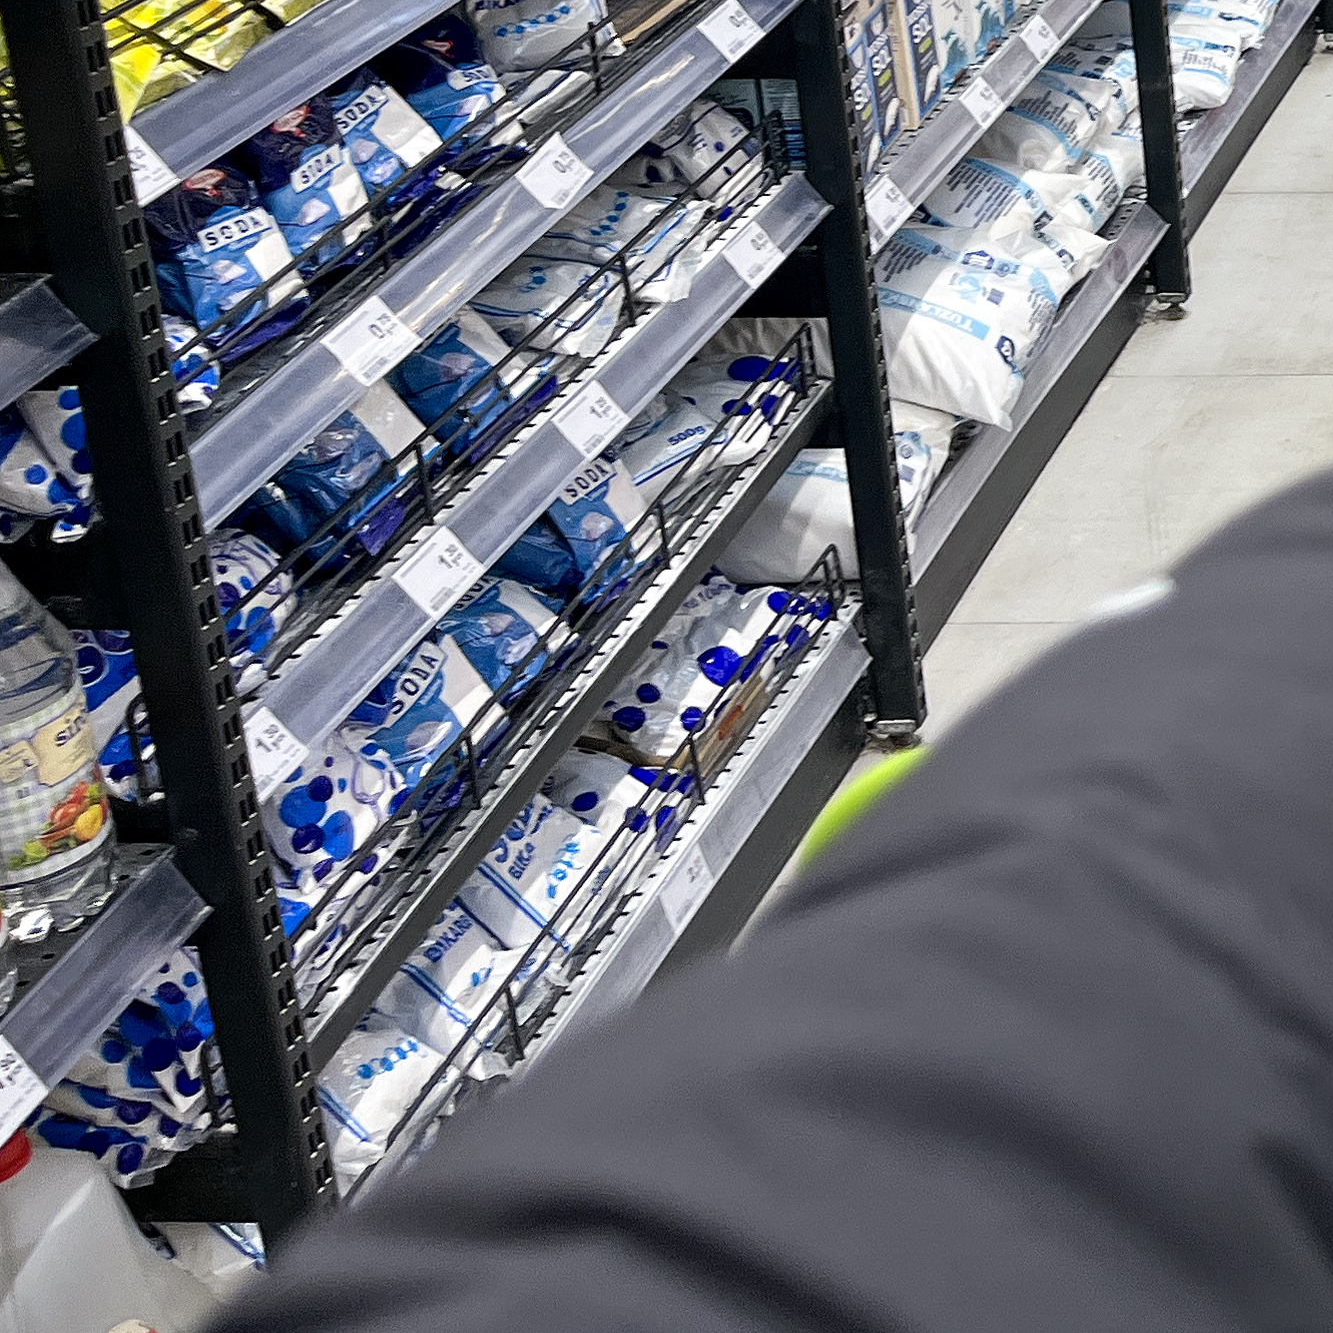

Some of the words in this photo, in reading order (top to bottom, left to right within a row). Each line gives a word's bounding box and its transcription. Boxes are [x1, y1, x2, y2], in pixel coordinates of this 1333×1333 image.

[337, 94, 380, 130] SODA
[203, 215, 262, 247] SODA
[566, 462, 609, 498] SODA
[391, 652, 438, 716] SODA
